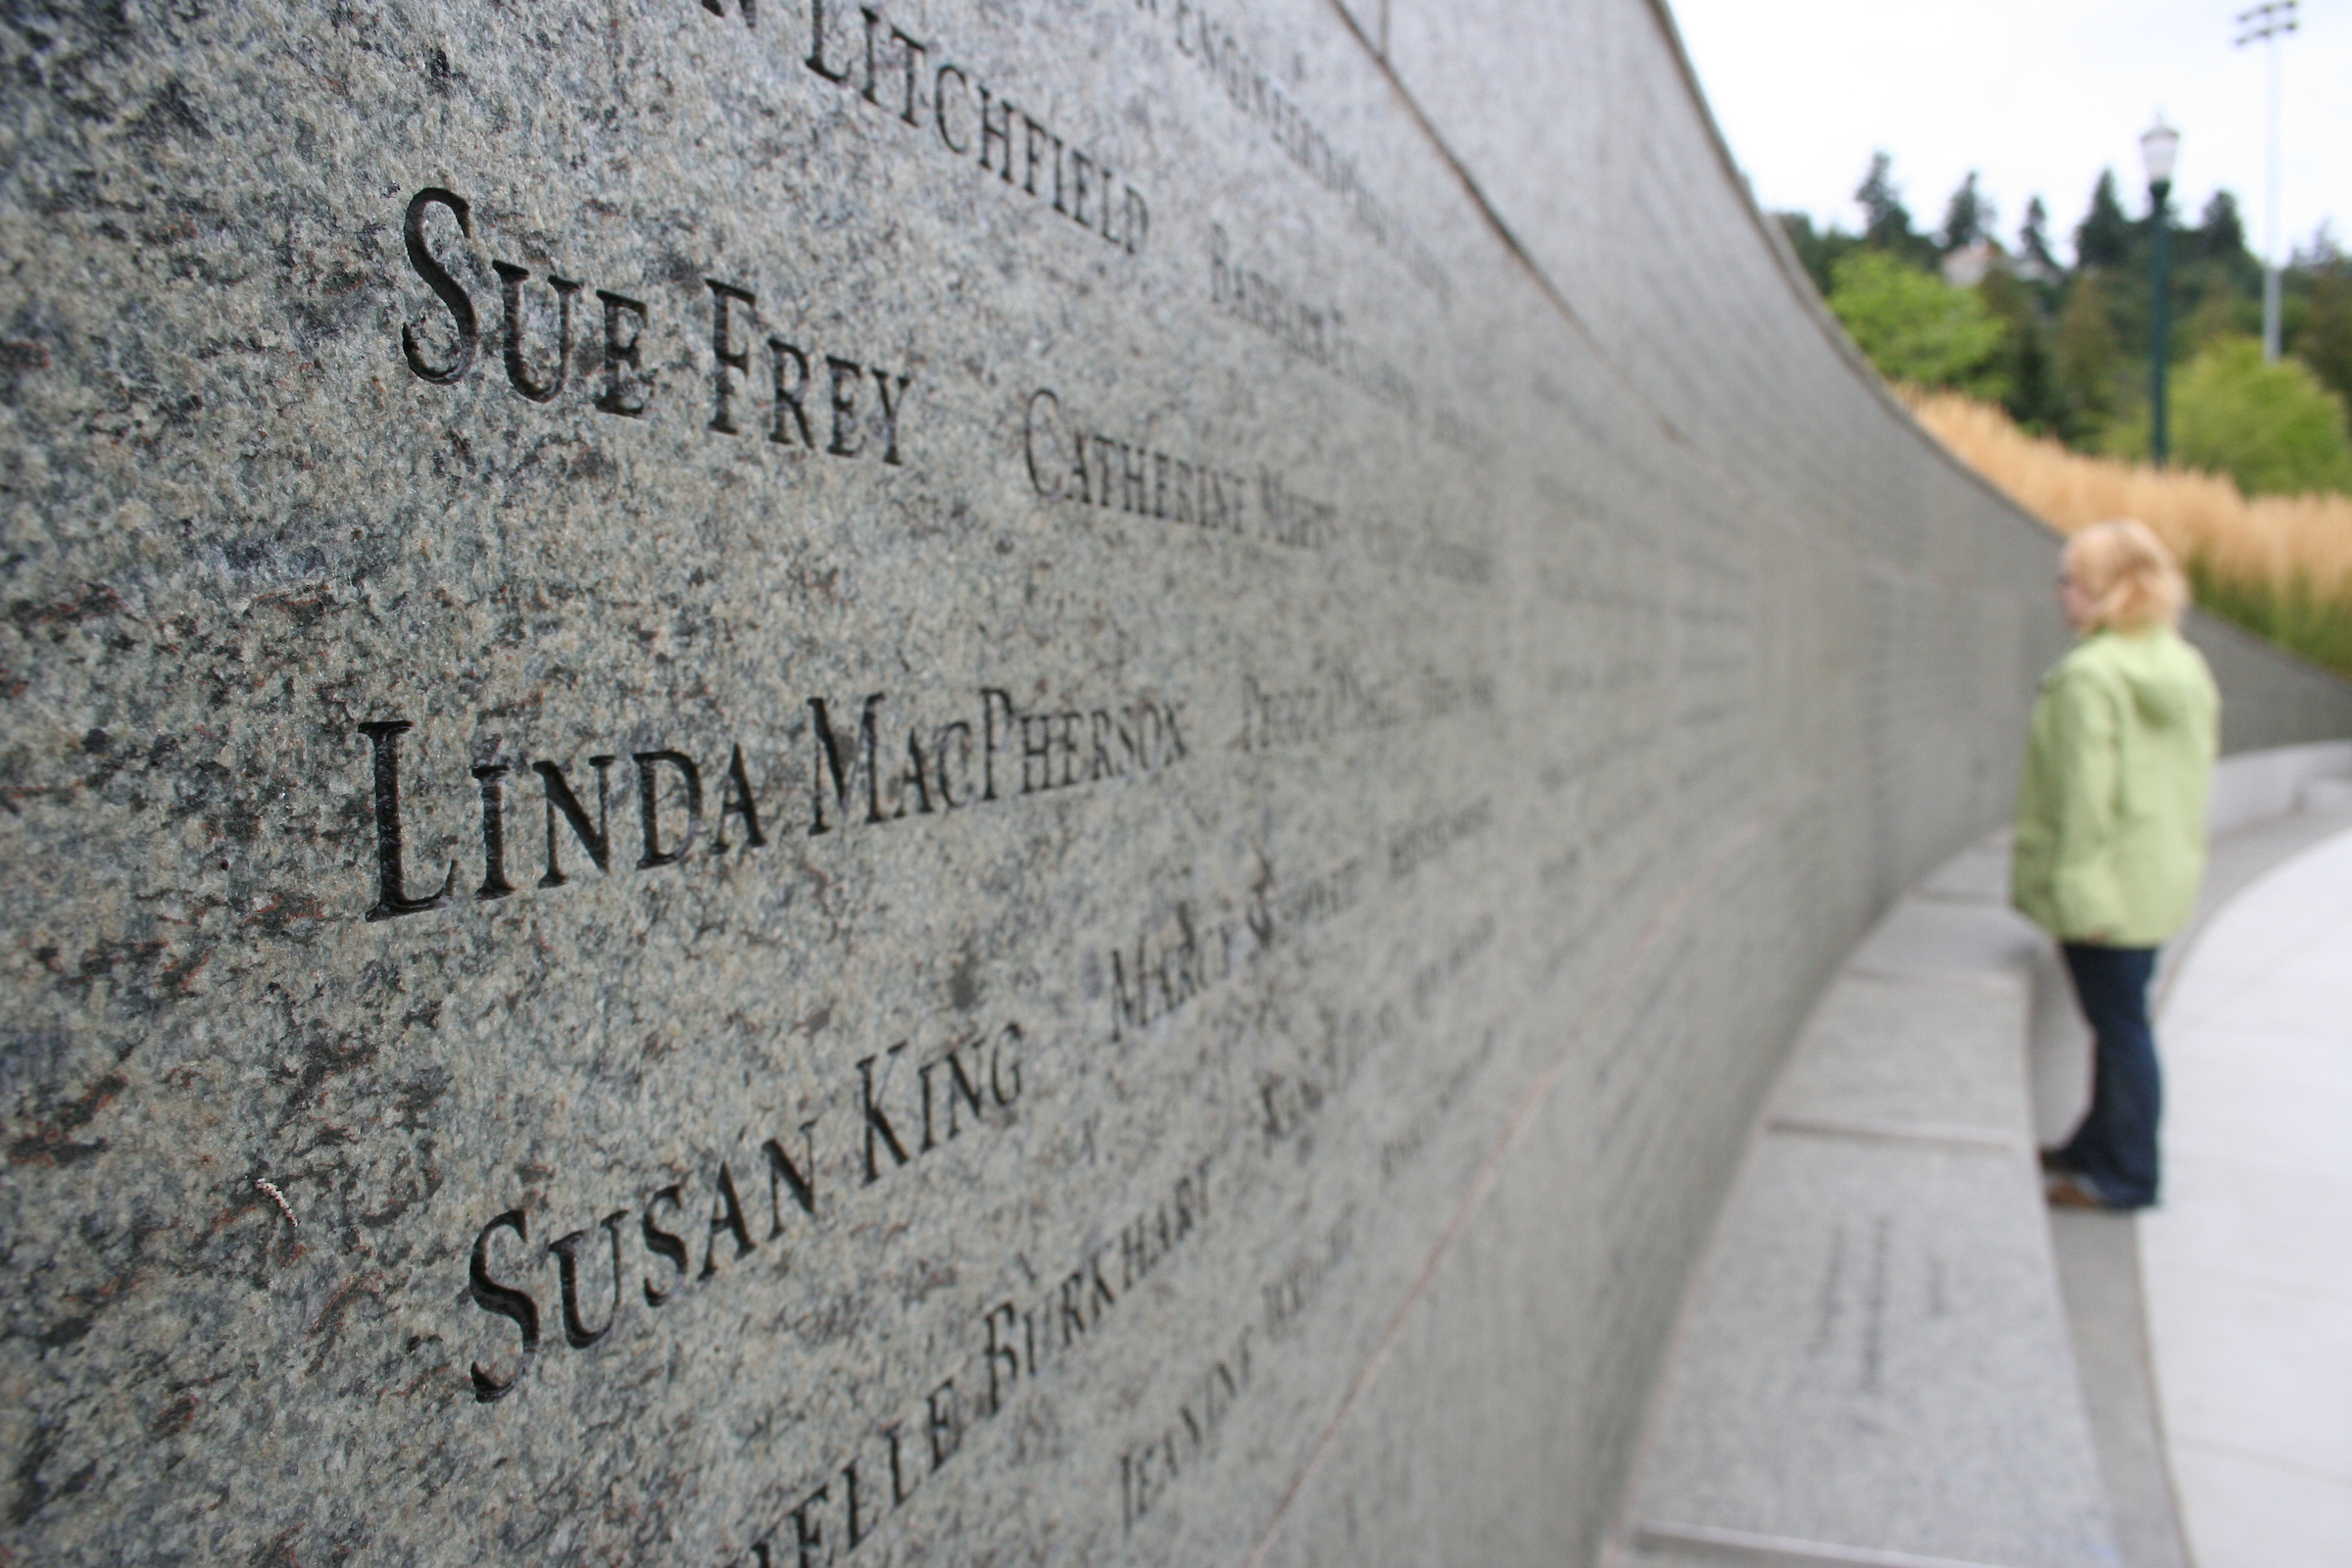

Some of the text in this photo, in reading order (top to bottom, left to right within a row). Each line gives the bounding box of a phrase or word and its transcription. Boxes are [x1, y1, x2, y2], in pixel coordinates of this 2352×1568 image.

[806, 0, 1149, 254] LITCHFIELD
[402, 186, 912, 466] SUE FREY
[1024, 388, 1247, 534] CATHERINE
[357, 719, 767, 922] LINDA
[806, 687, 1187, 836] MACPHERSON
[468, 1119, 817, 1403] SUSAN
[855, 1021, 1024, 1188] KING
